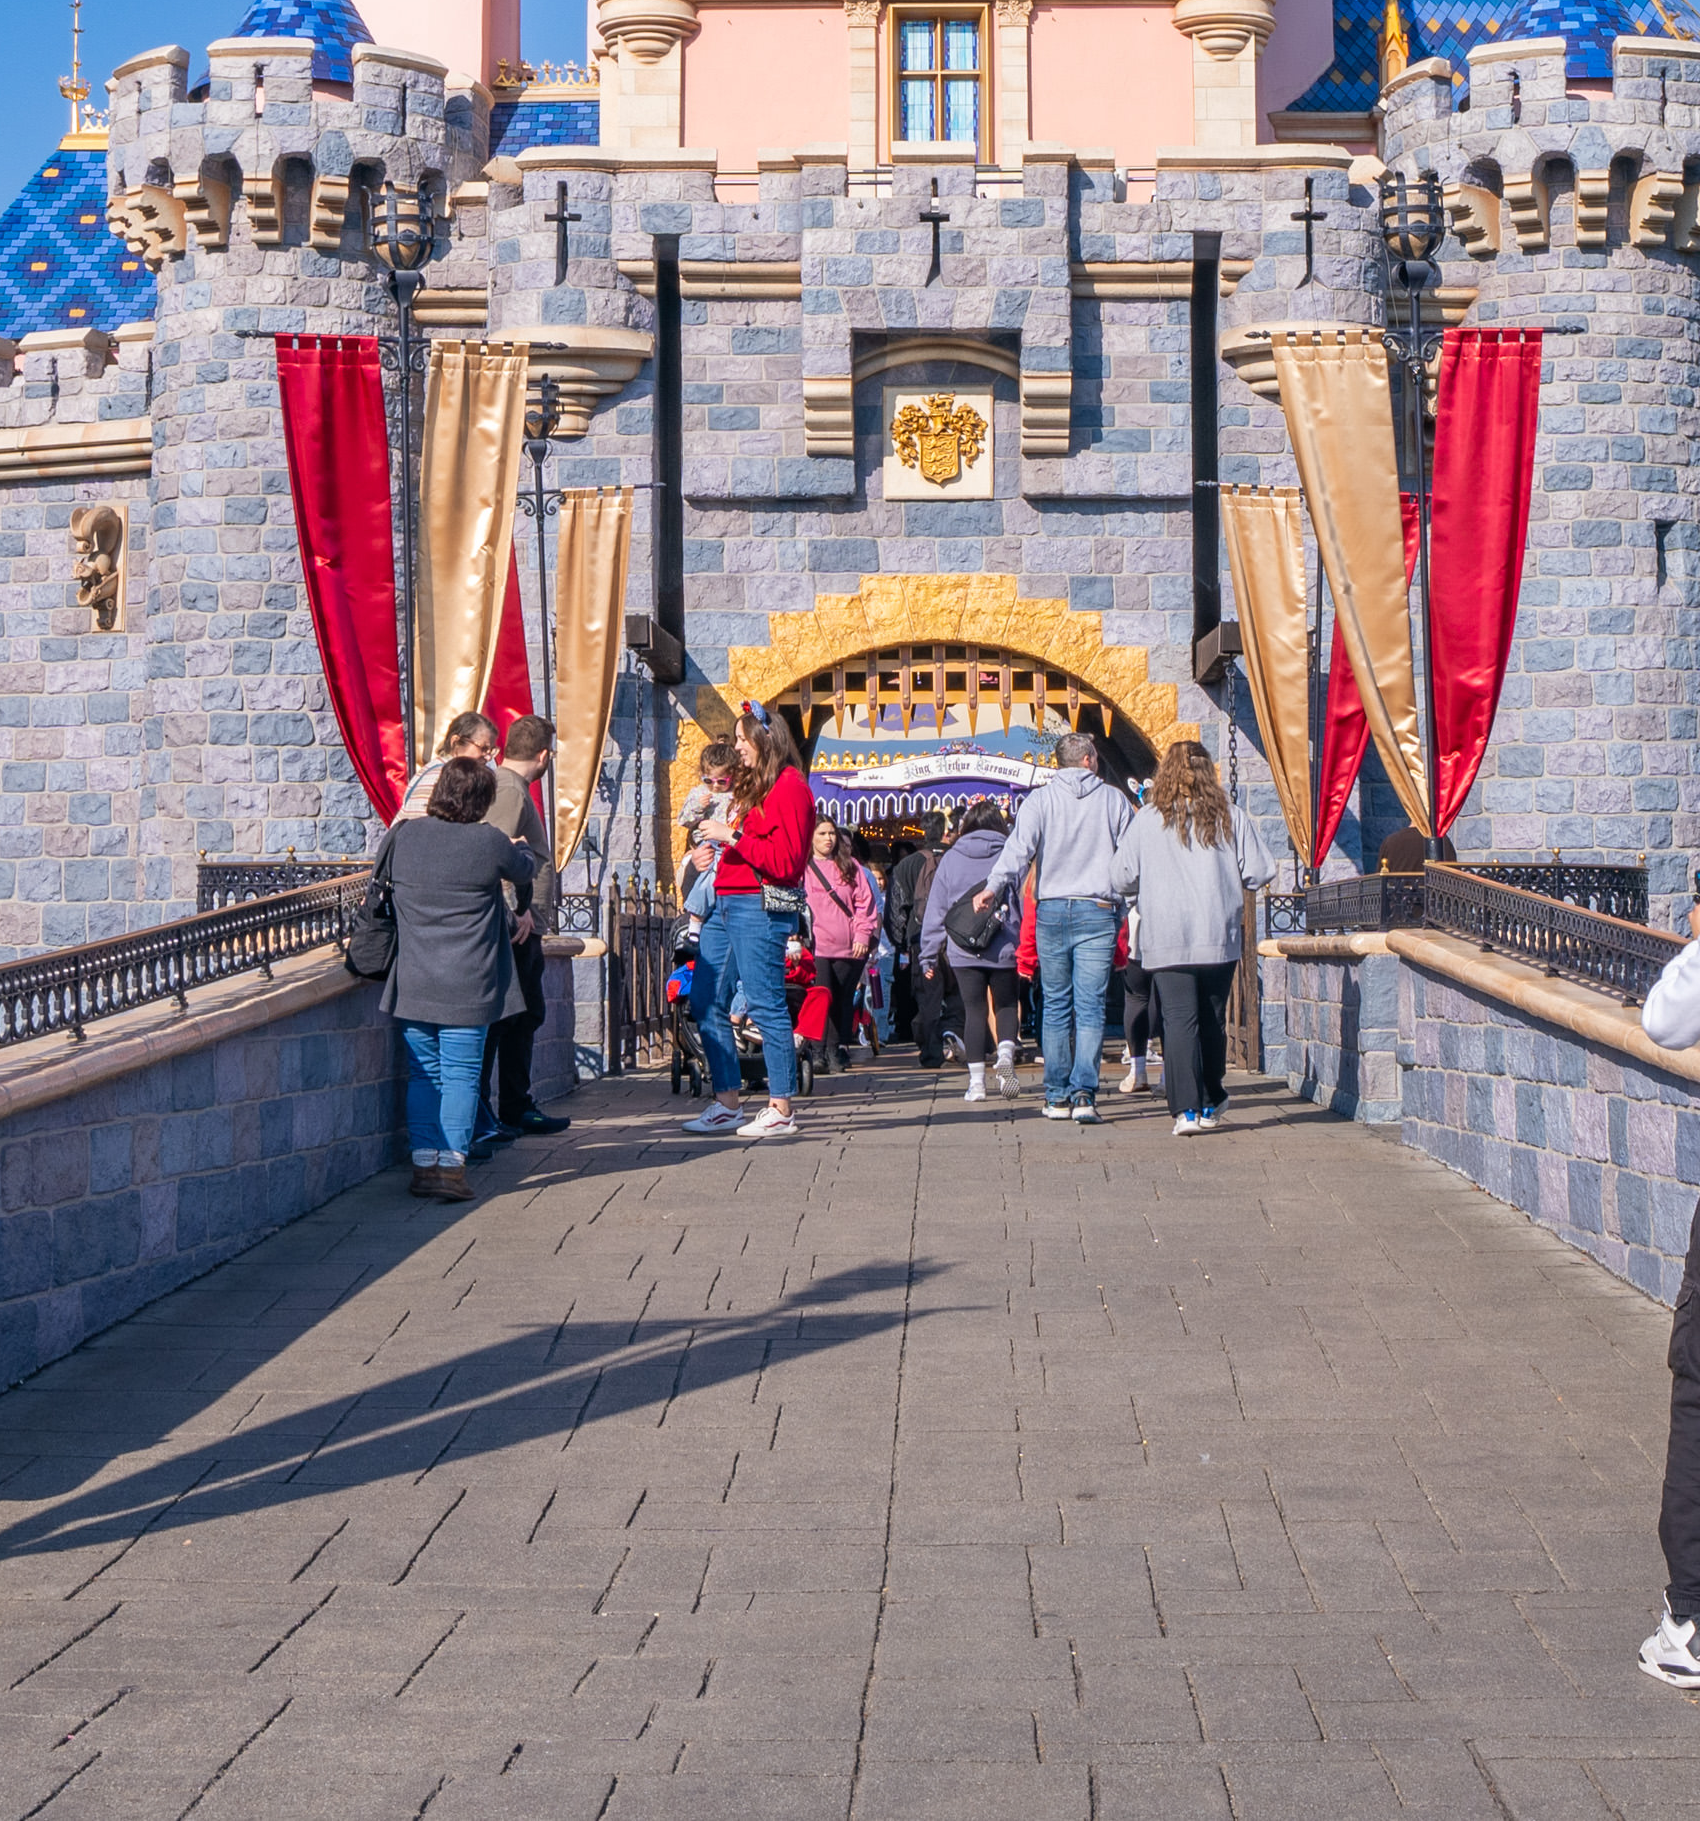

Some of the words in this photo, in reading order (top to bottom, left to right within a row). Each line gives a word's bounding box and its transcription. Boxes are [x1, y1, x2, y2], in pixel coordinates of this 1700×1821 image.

[904, 762, 933, 778] King
[935, 757, 970, 774] Arthur
[975, 759, 1021, 778] Carrousel
